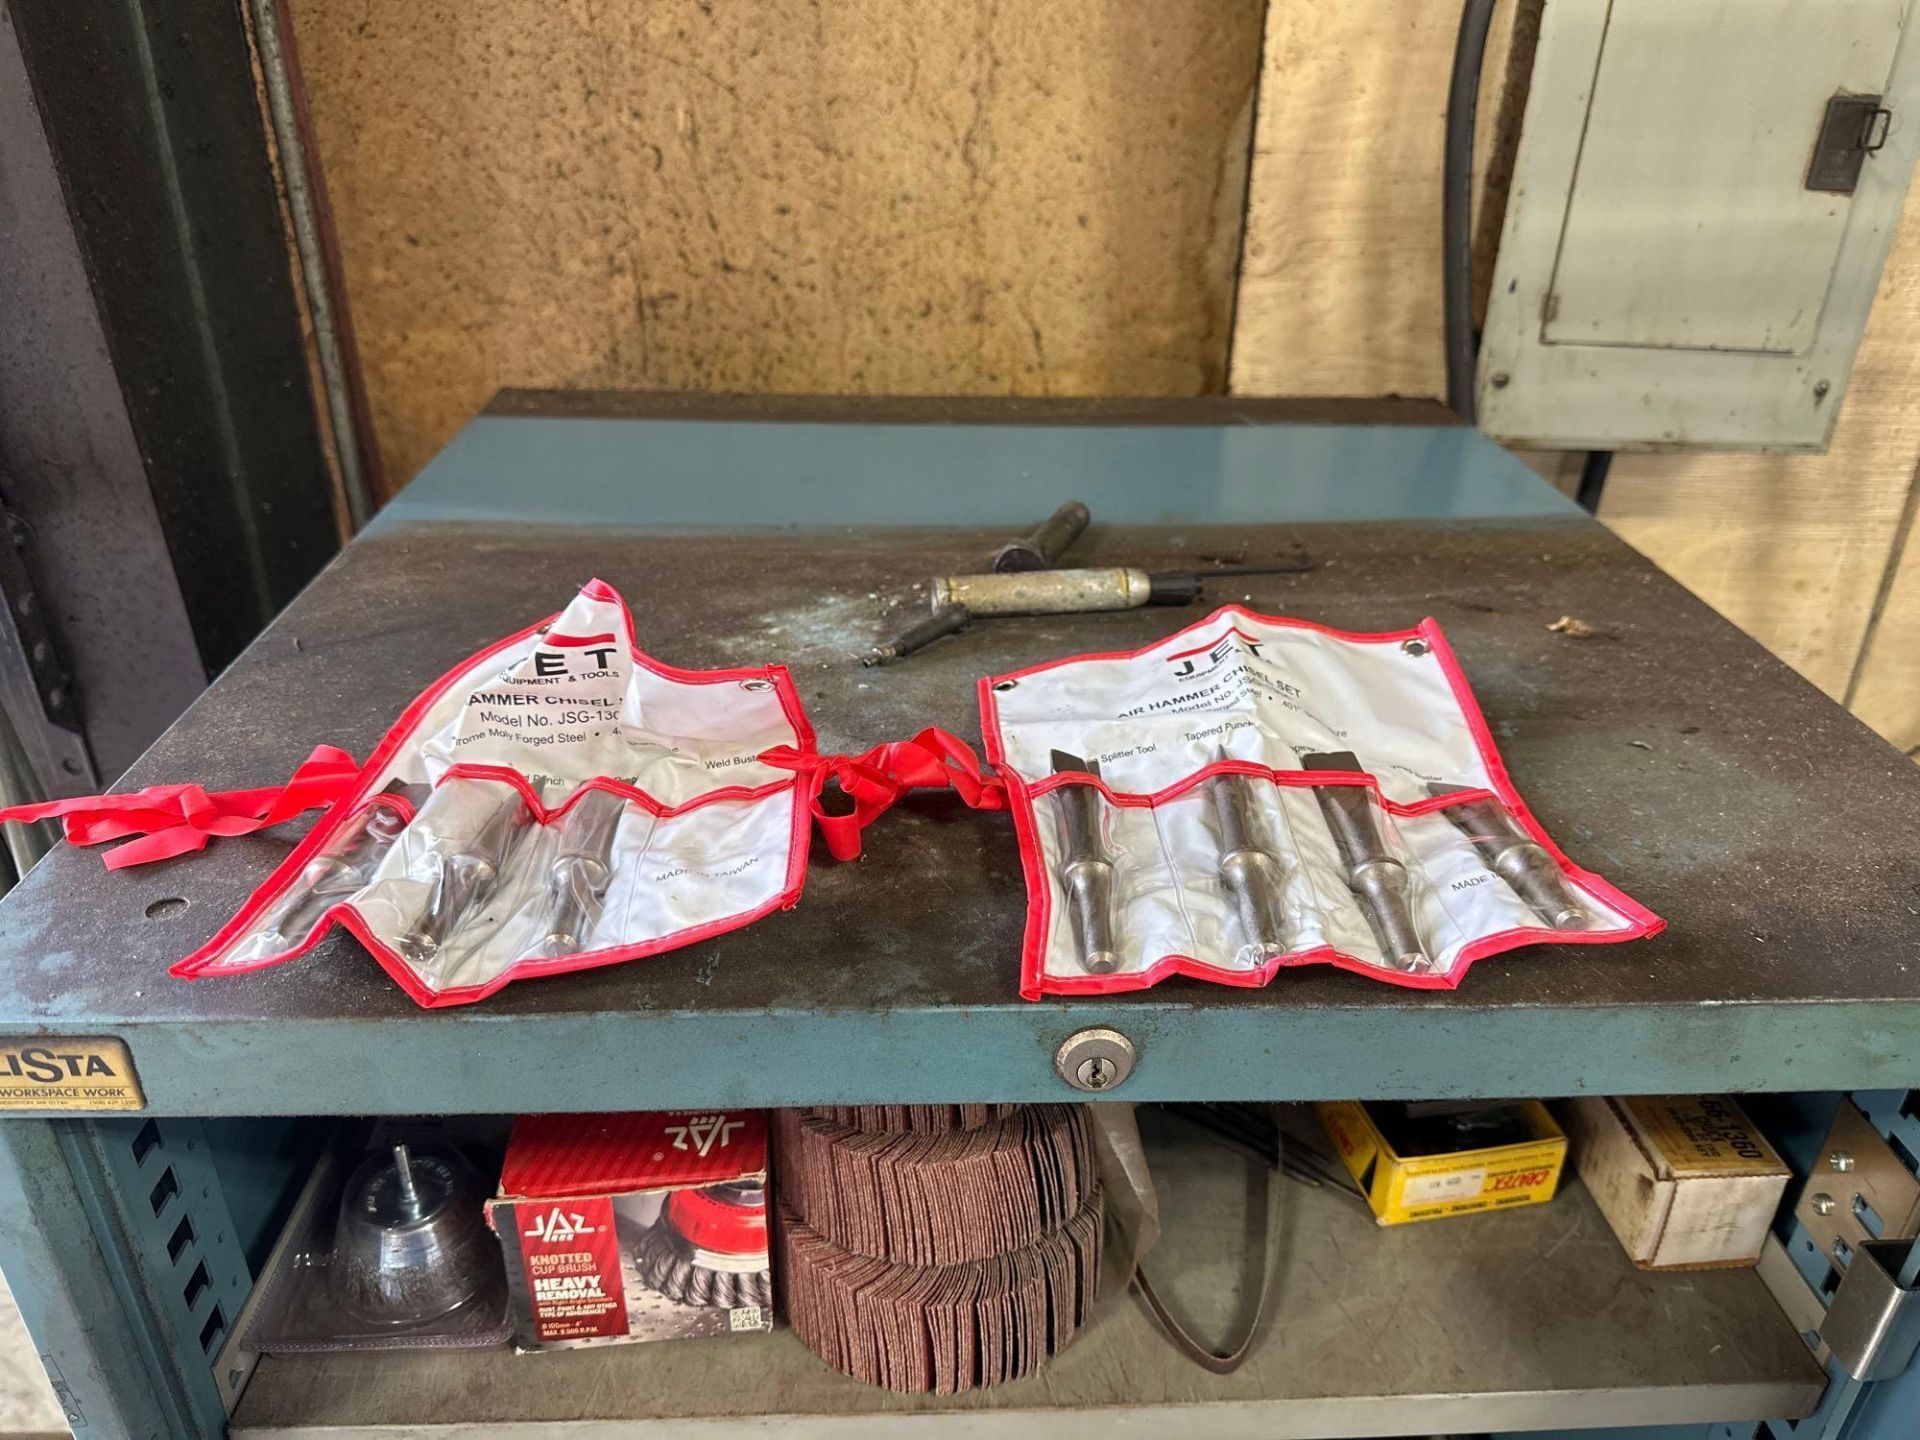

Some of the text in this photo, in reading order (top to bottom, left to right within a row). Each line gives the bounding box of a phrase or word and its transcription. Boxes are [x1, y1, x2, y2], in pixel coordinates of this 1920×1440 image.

[534, 648, 617, 677] ET
[1174, 640, 1264, 677] JET
[568, 675, 577, 683] &
[580, 671, 620, 679] TOOLS
[1118, 706, 1145, 718] AIR
[1150, 683, 1221, 710] HAMMER
[1223, 665, 1273, 686] CHISEL
[1276, 680, 1301, 698] SET
[468, 694, 540, 707] AMMER
[545, 696, 614, 707] CHISEL
[1172, 701, 1212, 714] Model
[480, 712, 522, 727] Model
[527, 714, 553, 727] No.
[455, 730, 486, 746] rome
[489, 729, 513, 740] Moly
[515, 734, 554, 746] Forged
[558, 732, 586, 743] Steel
[1184, 725, 1223, 743] Tapered
[1101, 748, 1134, 764] Splitter
[1138, 743, 1156, 754] Tool
[705, 754, 759, 770] Weld Bust
[533, 774, 565, 787] Pnch
[1451, 874, 1487, 891] MADE
[0, 1088, 126, 1097] WORKSPACE WORK
[524, 1207, 596, 1242] JAZ
[530, 1252, 592, 1266] KNOTTED
[532, 1262, 597, 1275] CUP BRUSH
[533, 1274, 601, 1291] HEAVY
[536, 1287, 606, 1301] REMOVAL
